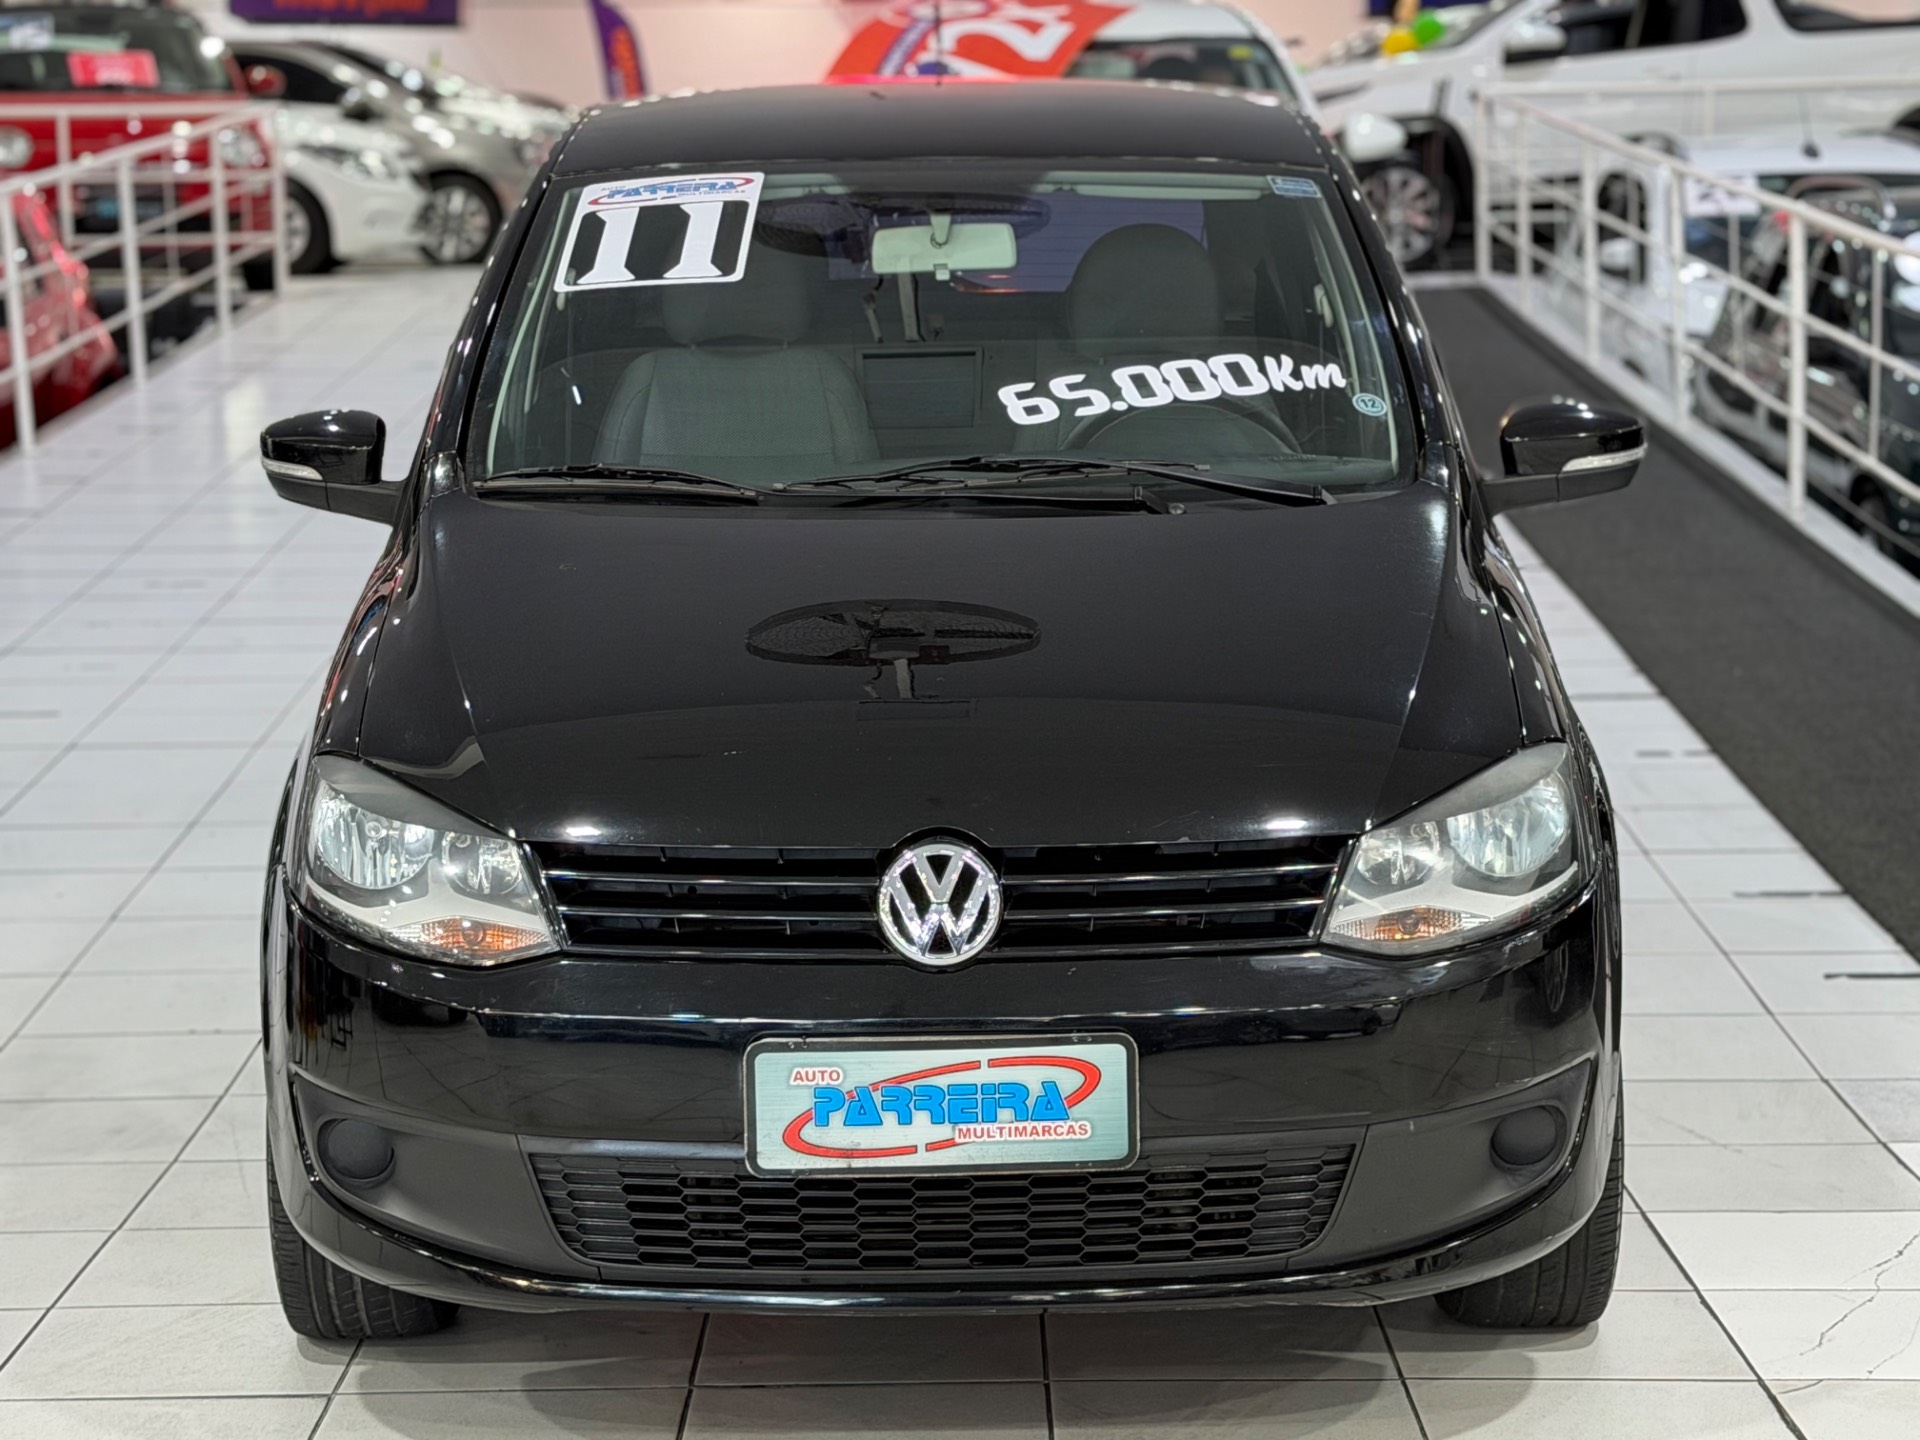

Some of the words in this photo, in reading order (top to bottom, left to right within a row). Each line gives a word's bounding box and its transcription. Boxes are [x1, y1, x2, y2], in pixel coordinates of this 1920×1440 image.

[576, 201, 724, 285] 11
[792, 1069, 841, 1083] AUTO
[813, 1080, 1071, 1127] PARREIRA
[957, 1122, 1089, 1140] MULTIMARCAS
